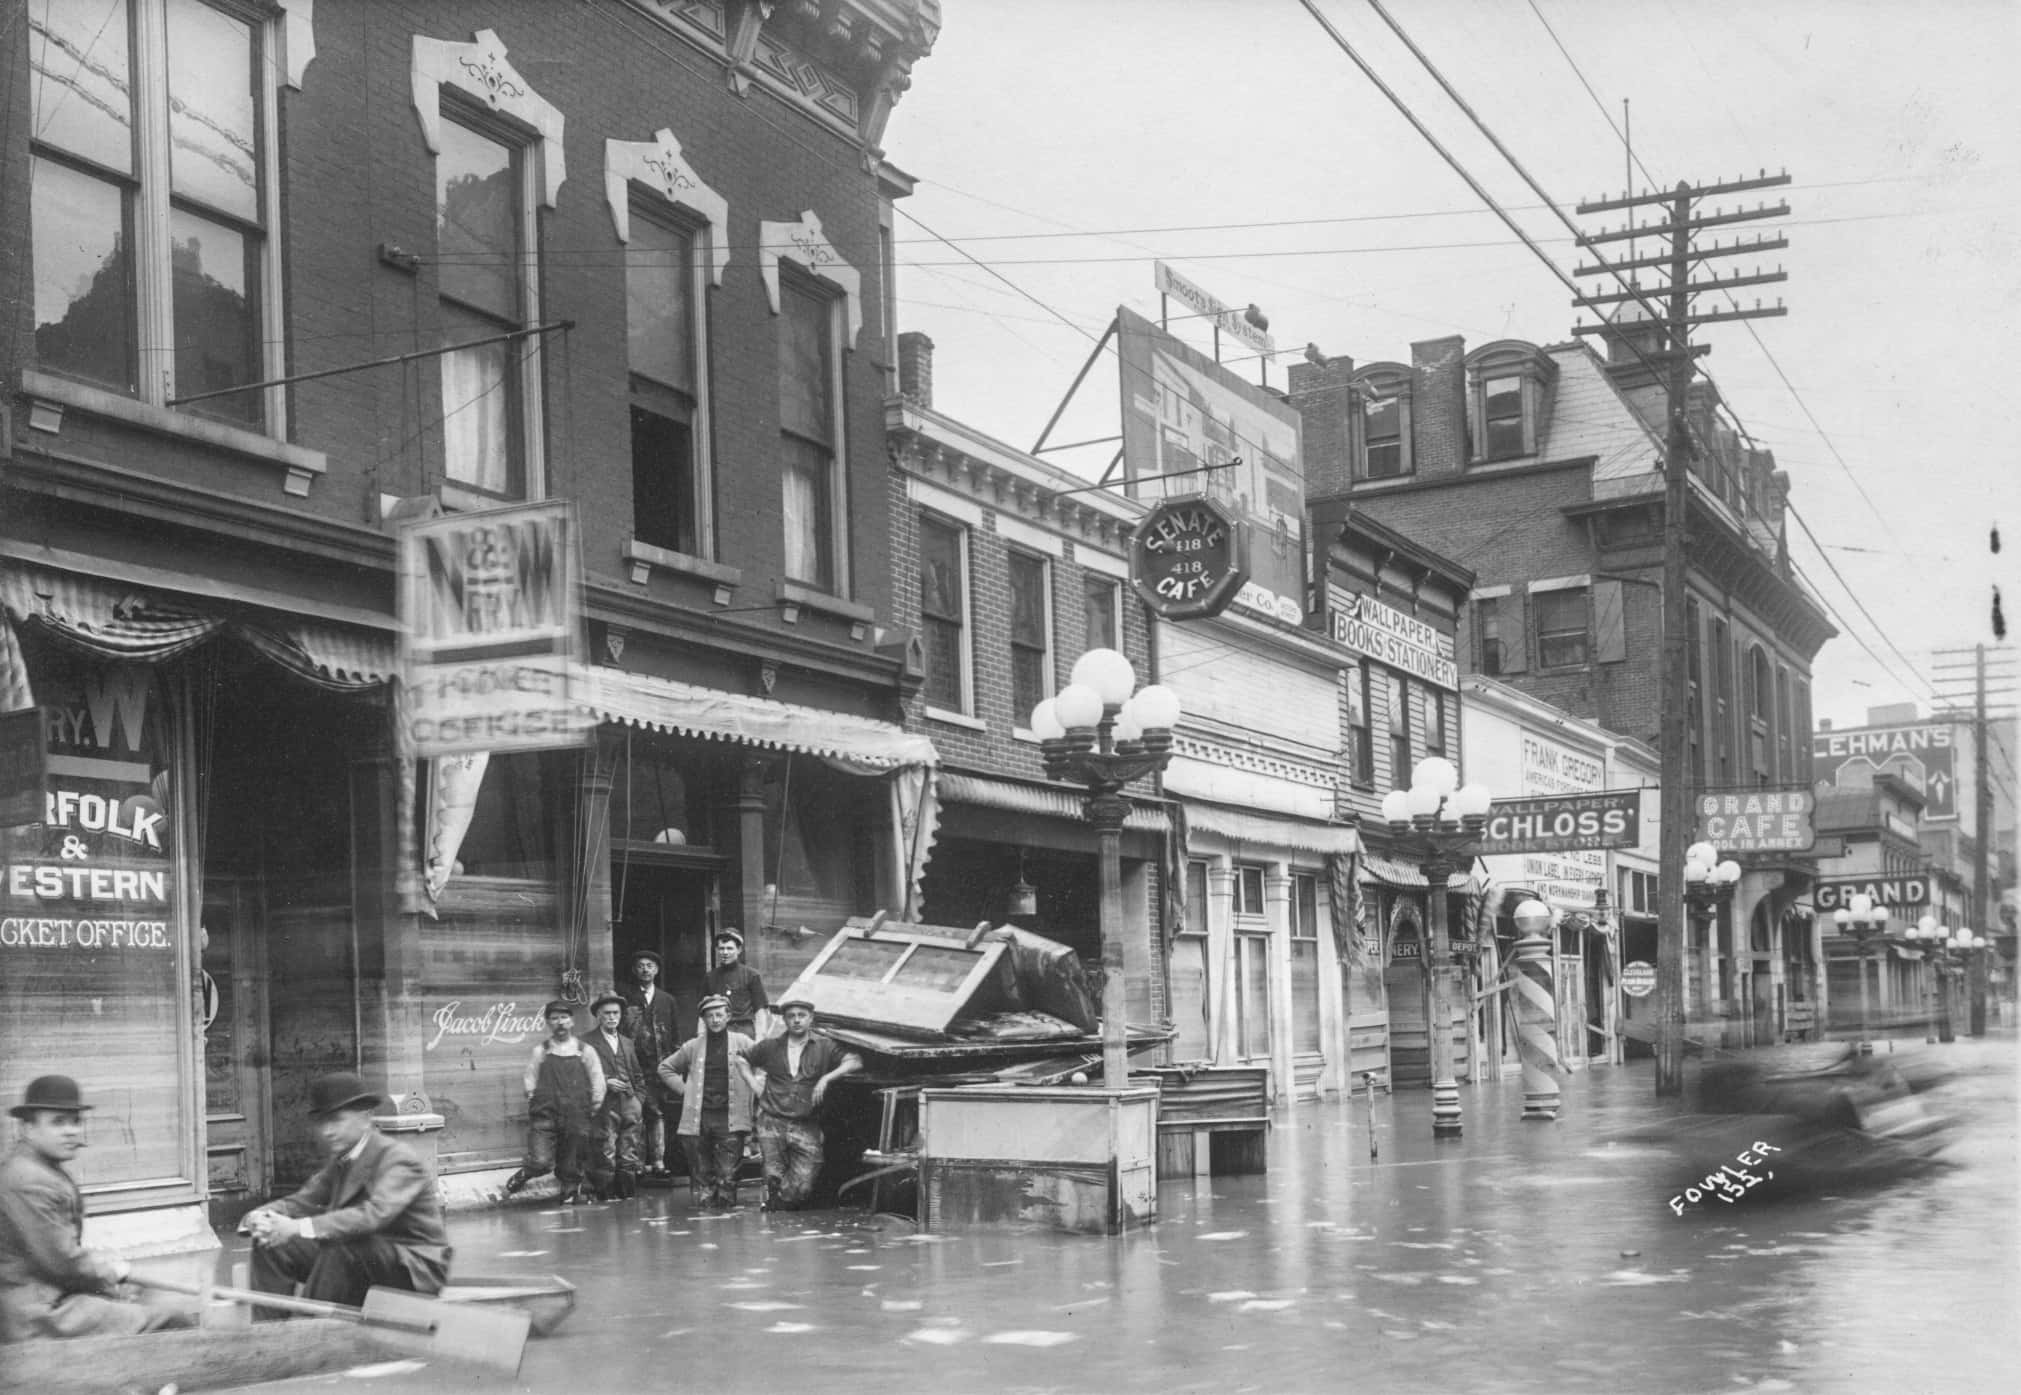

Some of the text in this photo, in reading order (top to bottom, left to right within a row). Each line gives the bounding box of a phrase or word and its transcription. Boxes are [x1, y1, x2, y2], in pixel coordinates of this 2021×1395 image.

[1145, 511, 1223, 555] SENATE
[1170, 560, 1203, 574] 418
[1156, 570, 1215, 600] CAFE
[1362, 598, 1433, 648] WALLPAPER
[1337, 614, 1458, 692] BOOKS STATIONERY
[86, 664, 148, 752] W
[1523, 738, 1559, 774] FRANK
[1703, 793, 1804, 816] GRAND
[1707, 814, 1800, 839] CAFE
[60, 835, 88, 860] &
[1740, 839, 1754, 849] IN
[0, 865, 166, 901] ESTERN
[1817, 880, 1925, 908] GRAND
[76, 919, 172, 948] OFFICE.
[425, 1000, 496, 1051] Jacob
